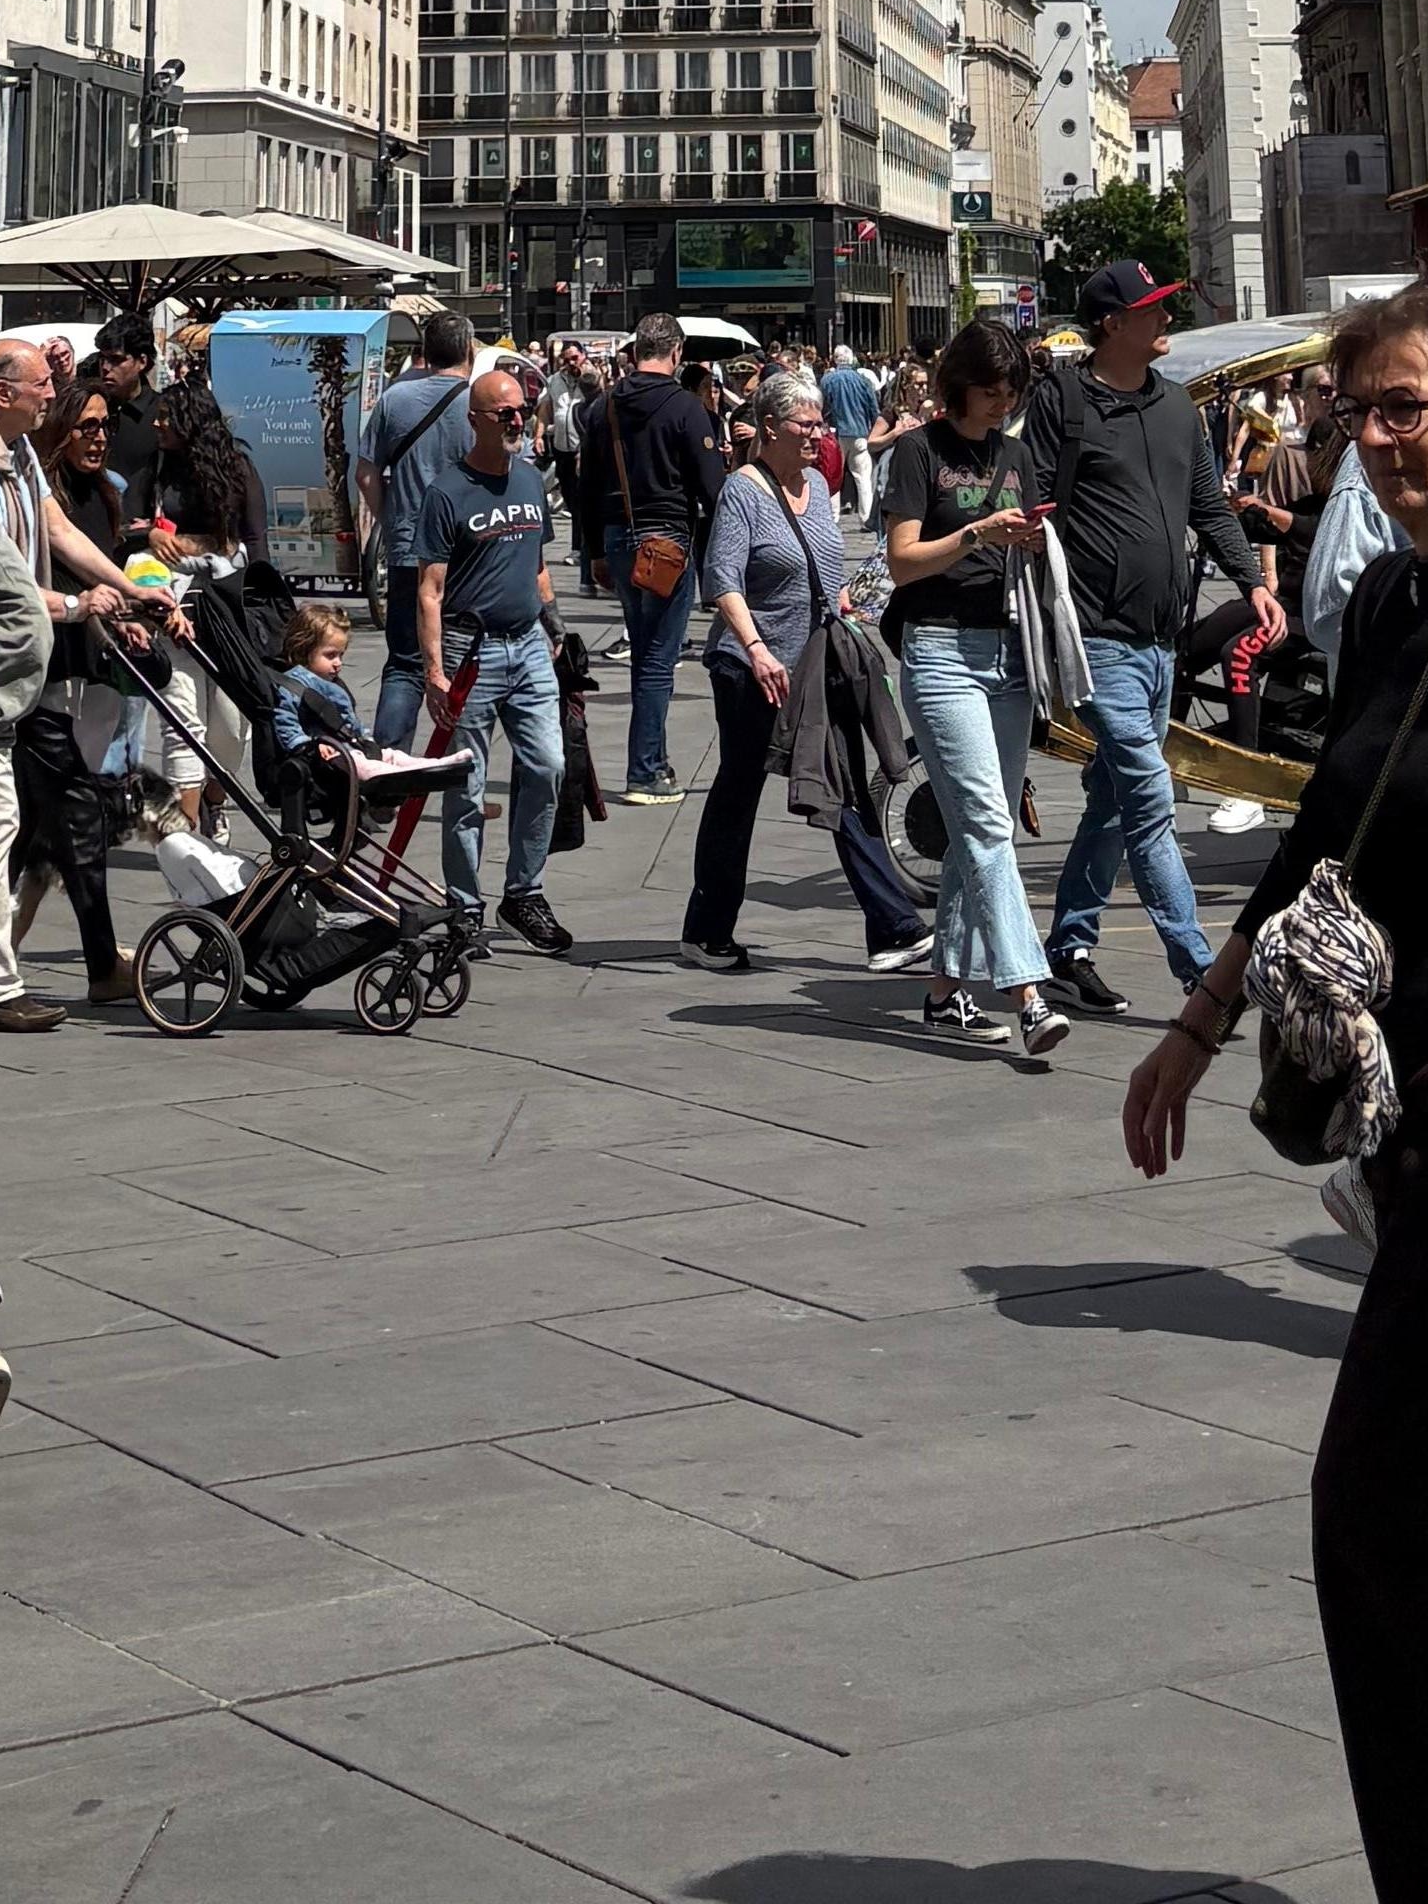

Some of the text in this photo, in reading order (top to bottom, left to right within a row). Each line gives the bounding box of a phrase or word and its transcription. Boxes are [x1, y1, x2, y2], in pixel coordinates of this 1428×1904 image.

[264, 418, 312, 434] You only
[262, 432, 315, 444] live once.
[468, 503, 542, 532] CAPRI
